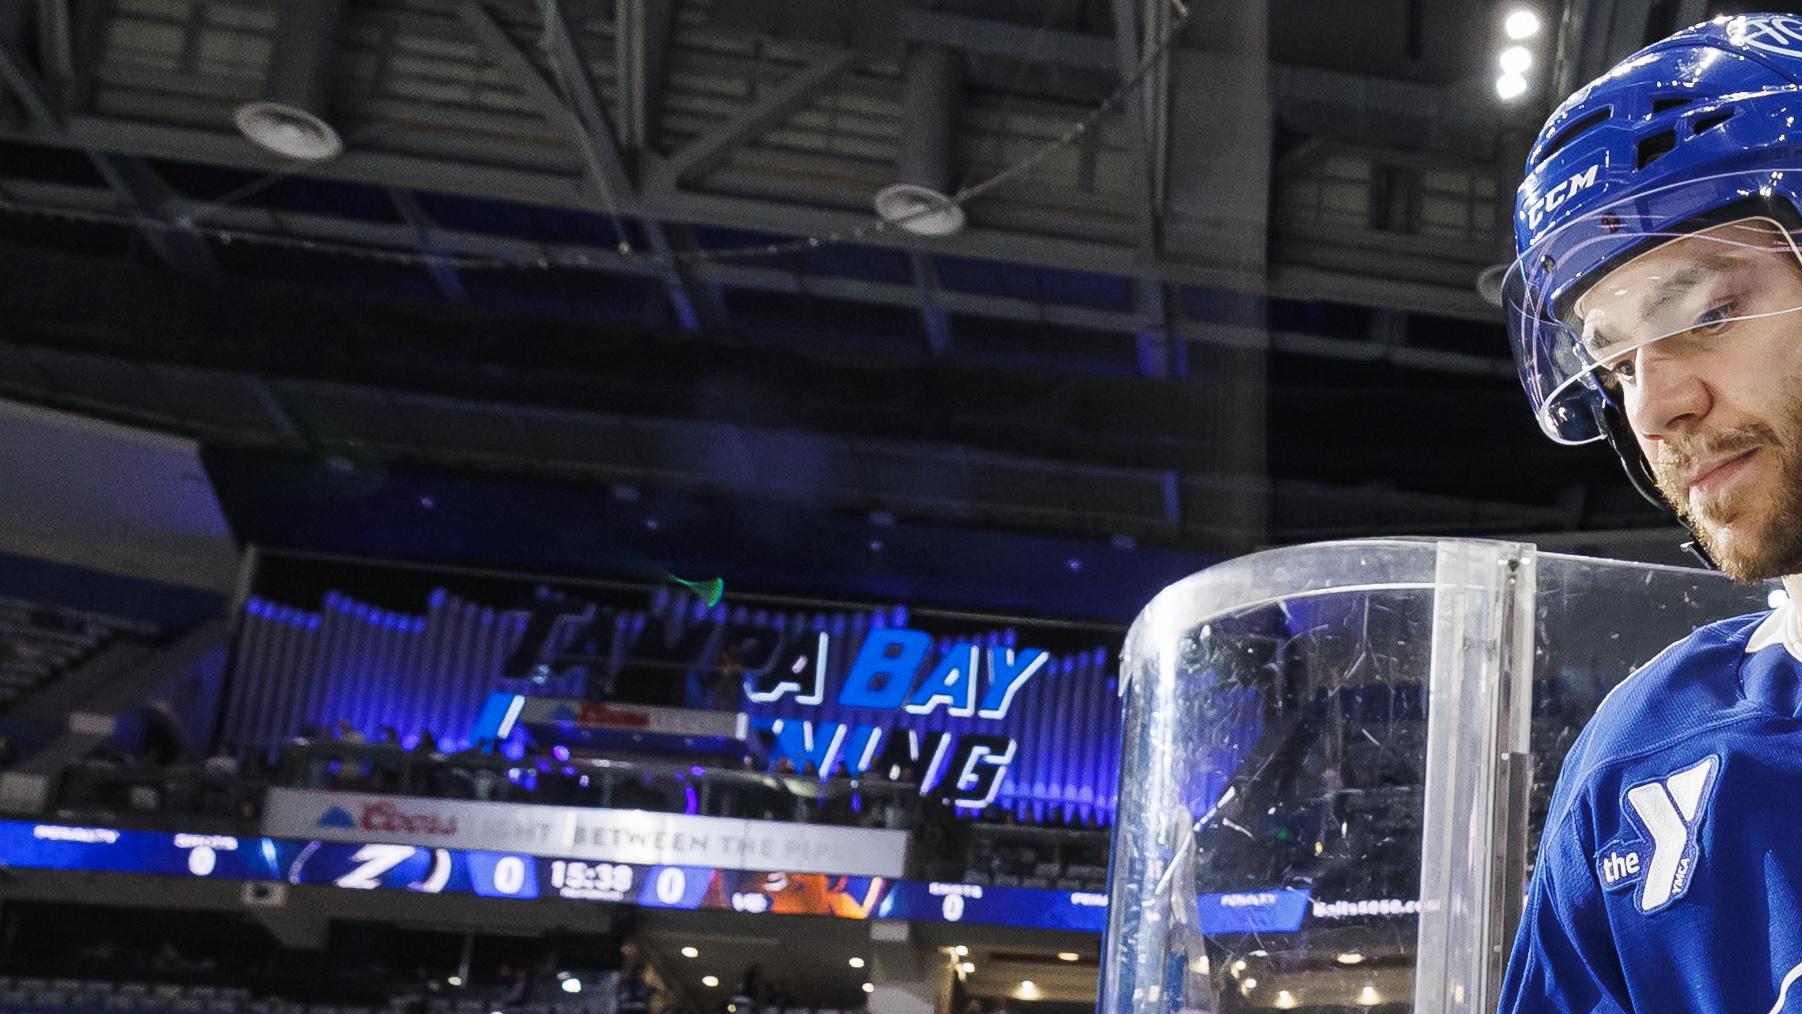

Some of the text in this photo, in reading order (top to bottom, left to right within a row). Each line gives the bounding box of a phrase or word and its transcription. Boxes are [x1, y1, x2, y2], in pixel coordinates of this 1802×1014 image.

[1528, 165, 1599, 230] CCM
[837, 627, 1049, 720] BAY
[573, 824, 709, 852] BETWEEN
[1603, 758, 1713, 911] the Y
[494, 856, 525, 894] 0
[656, 867, 686, 904] 0
[1672, 858, 1691, 894] YMCA
